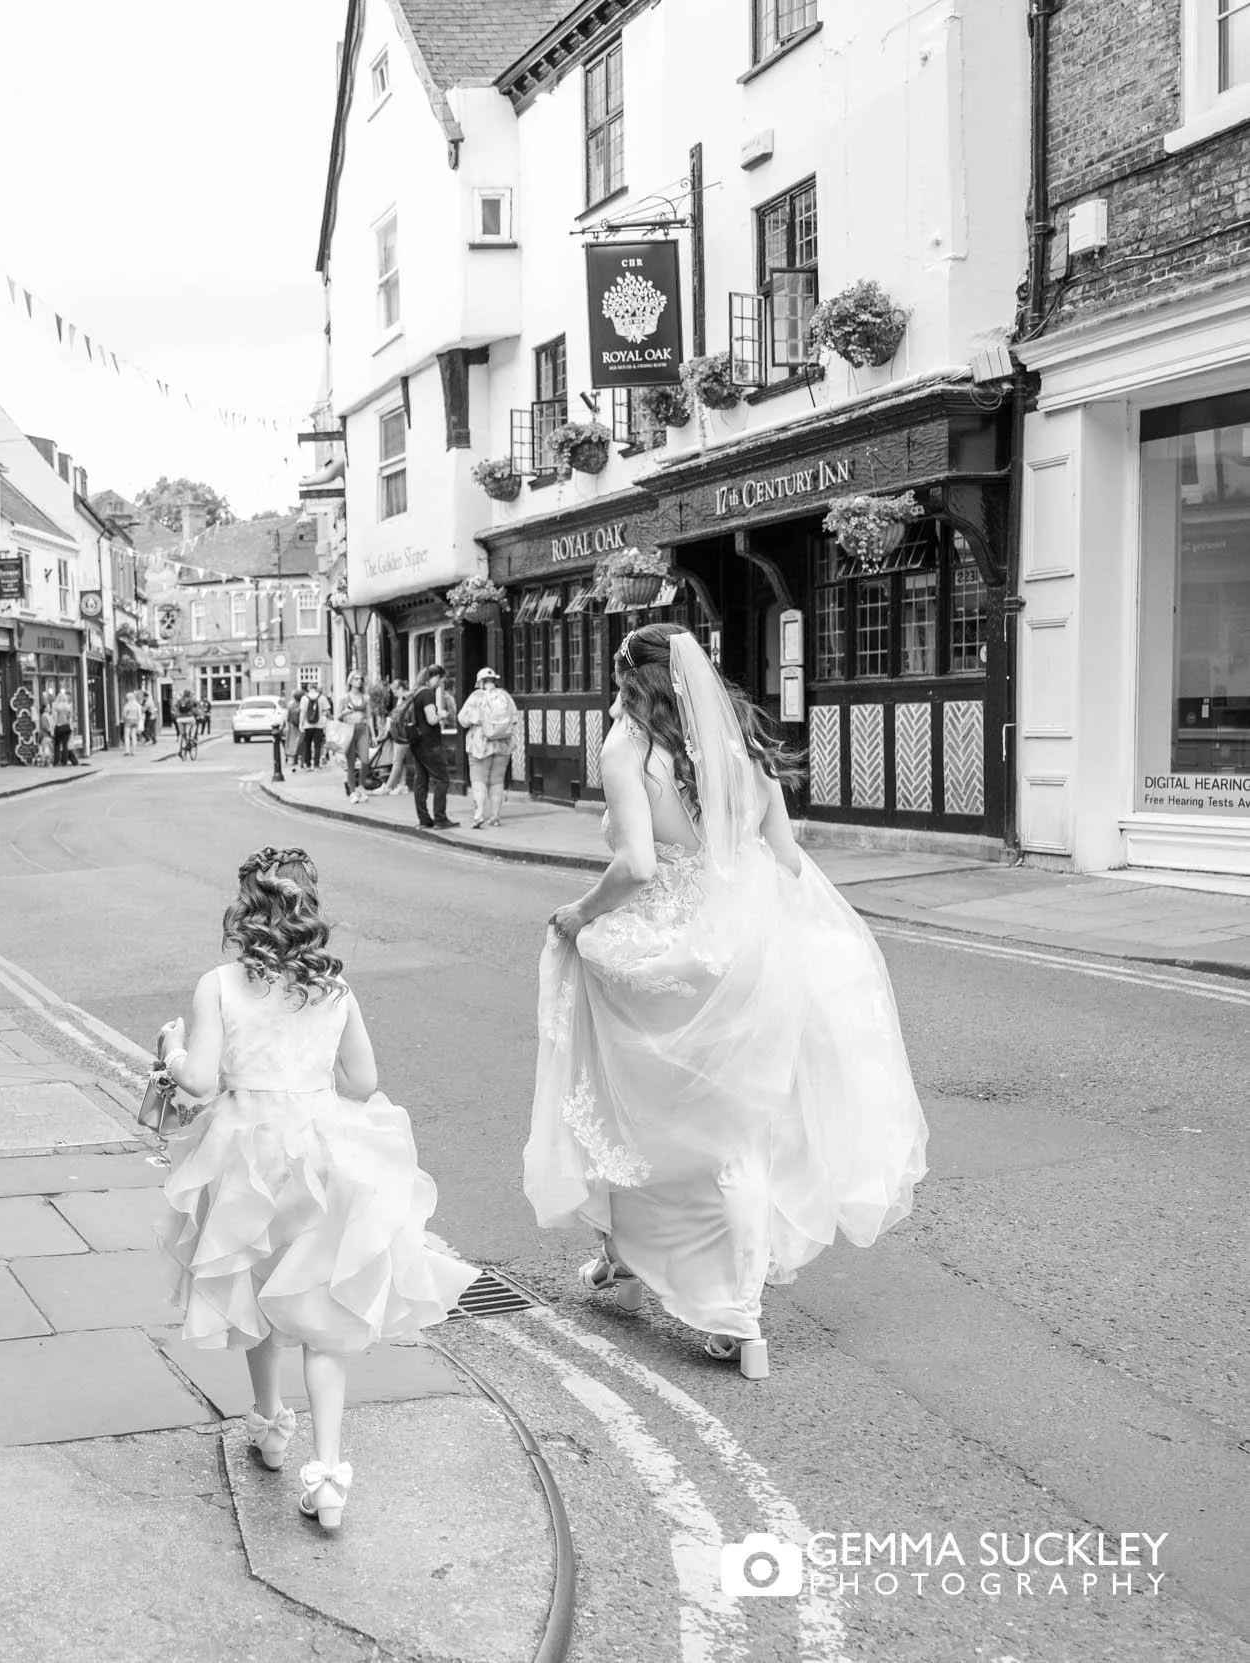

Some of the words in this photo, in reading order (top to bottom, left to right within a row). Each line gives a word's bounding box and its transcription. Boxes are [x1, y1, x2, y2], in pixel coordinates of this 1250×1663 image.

[602, 350, 643, 364] ROYAL
[644, 347, 673, 361] OAK
[742, 468, 814, 508] CENTURY
[818, 459, 850, 490] INN
[552, 532, 591, 562] ROYAL
[595, 523, 625, 552] OAK
[1144, 776, 1190, 790] DIGITAL
[1195, 777, 1250, 791] HEARING
[1144, 794, 1164, 805] Free
[1168, 795, 1204, 808] Hearing
[1208, 796, 1234, 808] Tests
